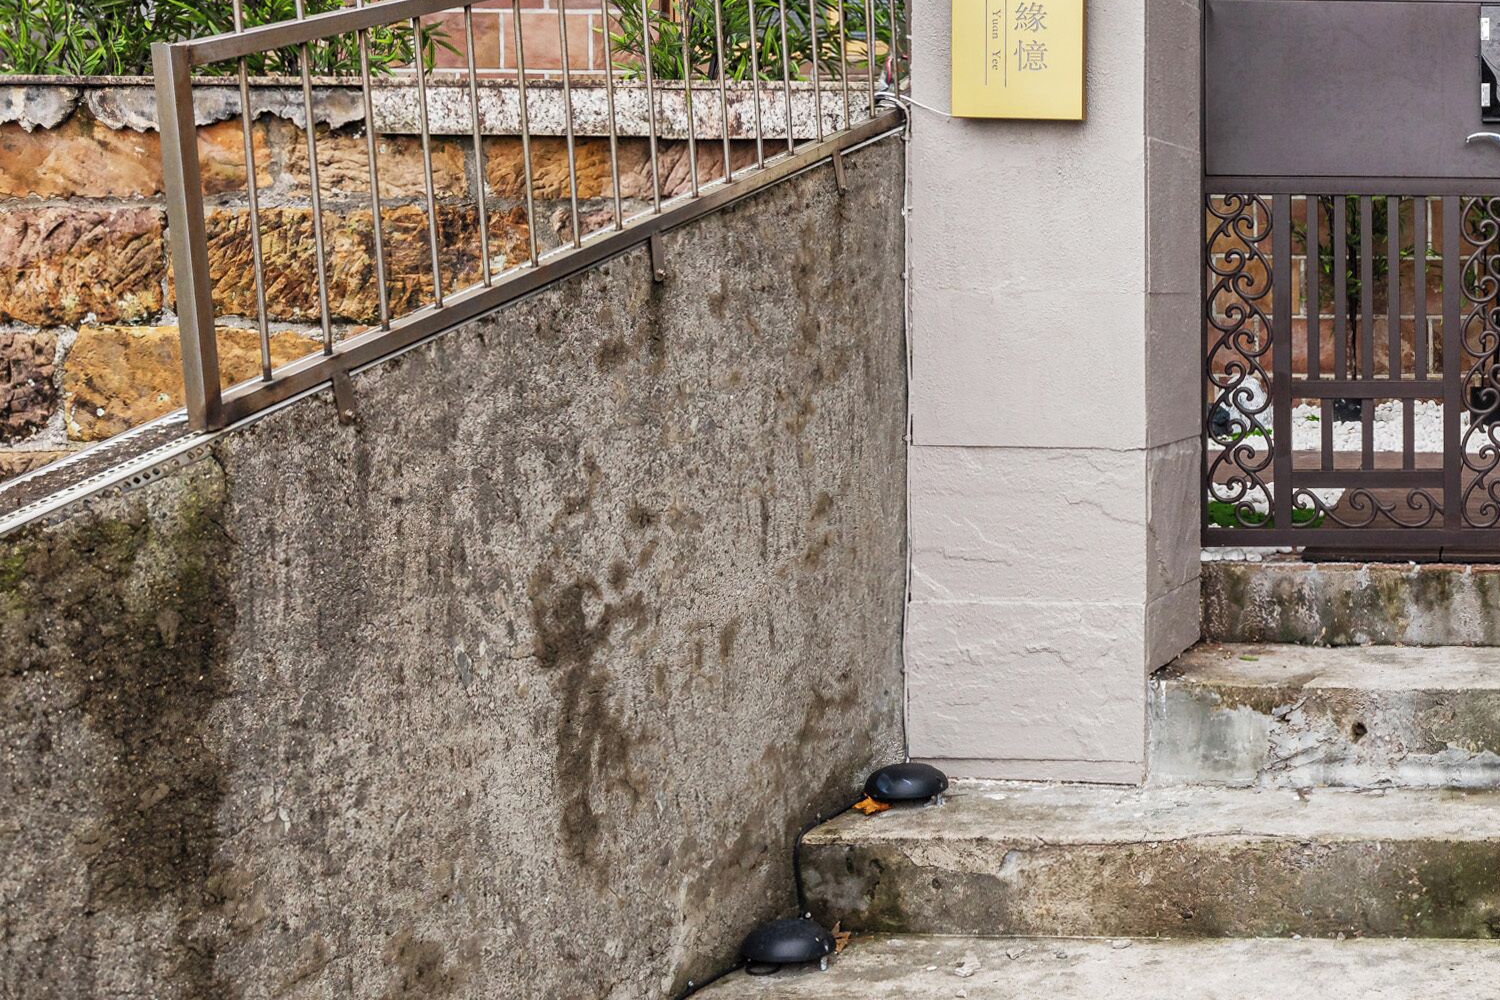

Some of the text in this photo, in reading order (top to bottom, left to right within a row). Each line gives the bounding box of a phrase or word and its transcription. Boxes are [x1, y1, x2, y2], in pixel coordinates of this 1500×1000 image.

[992, 10, 1002, 71] Yuan Yee
[1014, 2, 1048, 72] 緣憶
